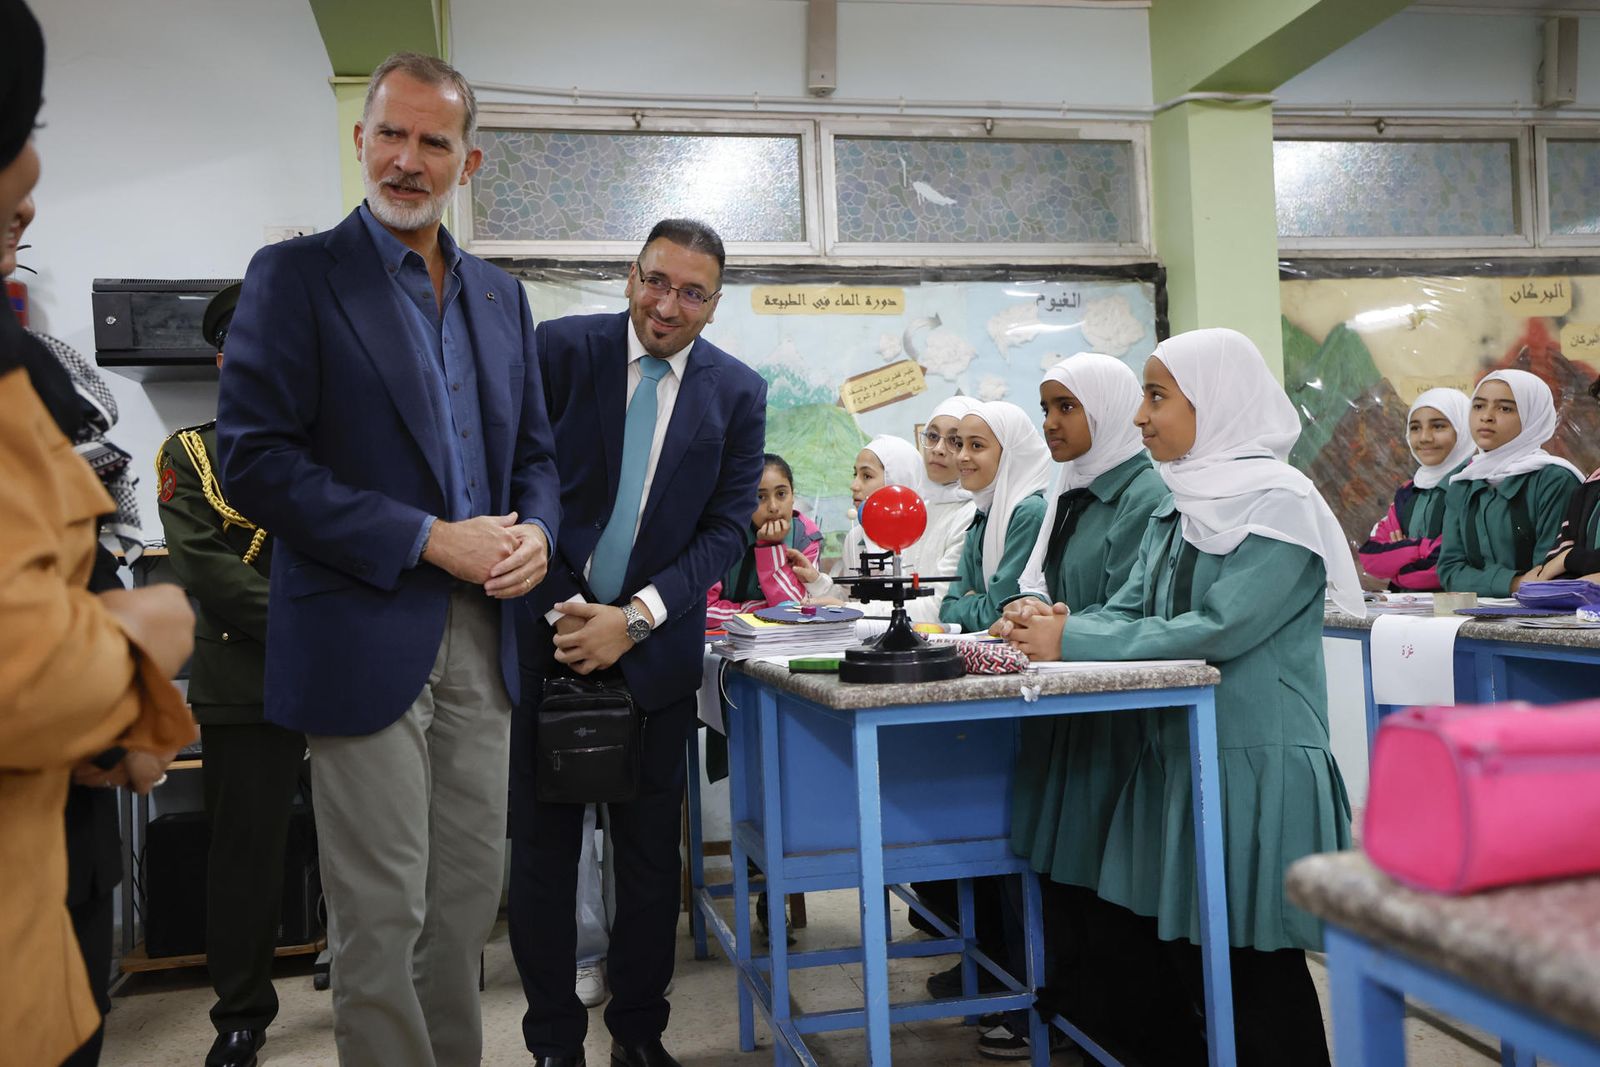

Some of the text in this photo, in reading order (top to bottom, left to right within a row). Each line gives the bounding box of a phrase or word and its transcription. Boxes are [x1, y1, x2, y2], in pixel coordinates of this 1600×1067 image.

[764, 292, 897, 310] دورة الماء في الطبيعة
[1036, 292, 1081, 312] الغيوم
[1509, 282, 1565, 304] البركان
[1401, 644, 1414, 659] غزة
